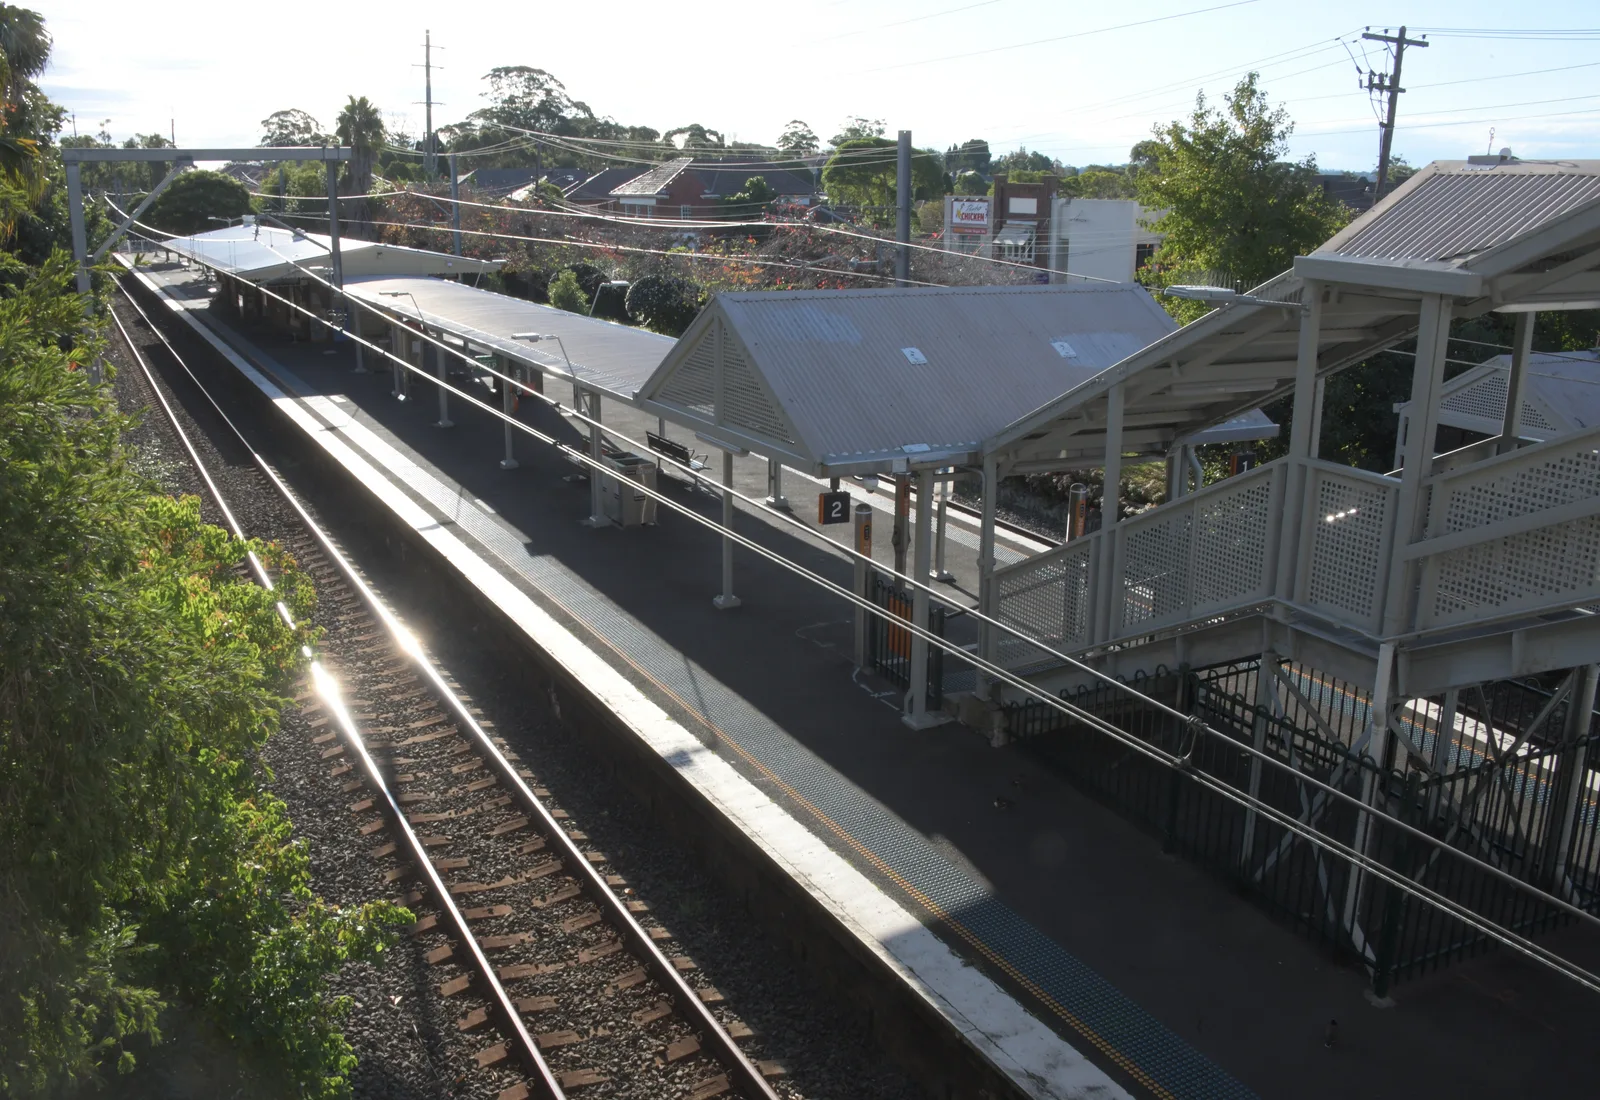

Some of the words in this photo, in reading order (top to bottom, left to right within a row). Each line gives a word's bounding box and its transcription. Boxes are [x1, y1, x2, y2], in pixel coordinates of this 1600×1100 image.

[961, 212, 984, 221] CHICKEN
[1242, 460, 1248, 473] 1
[831, 501, 842, 517] 2
